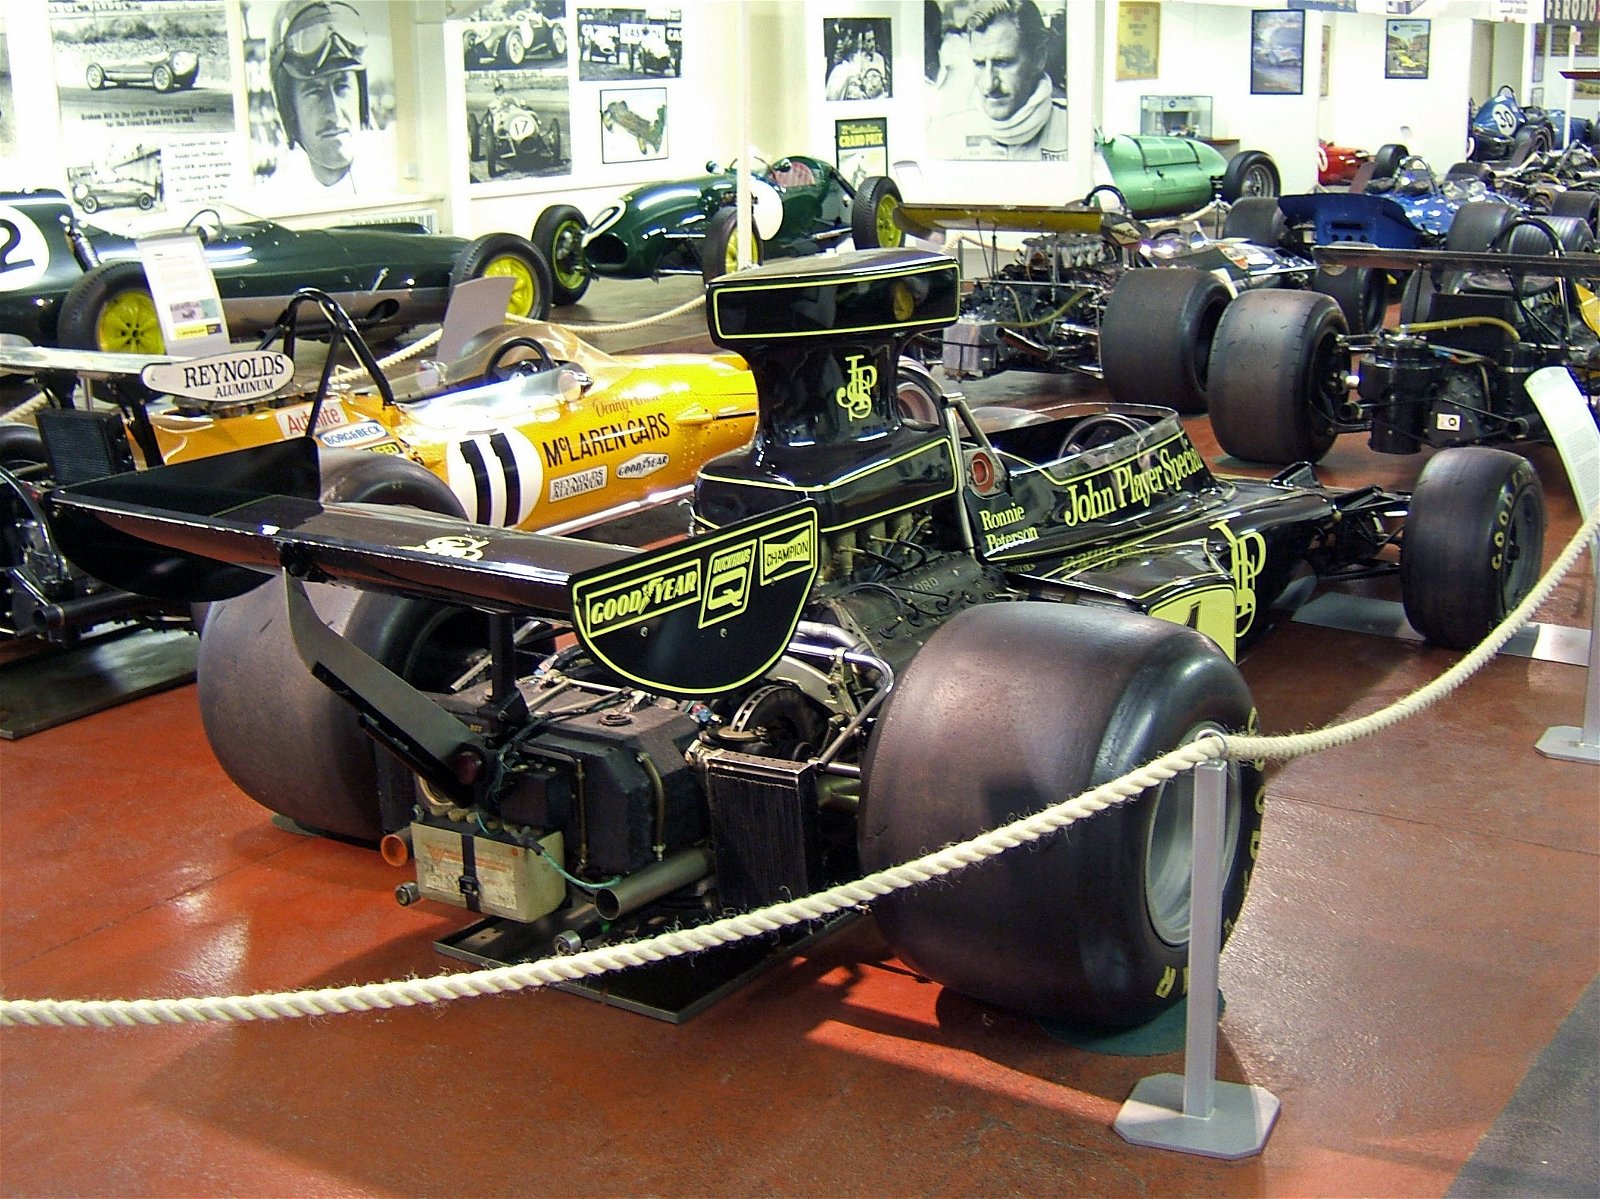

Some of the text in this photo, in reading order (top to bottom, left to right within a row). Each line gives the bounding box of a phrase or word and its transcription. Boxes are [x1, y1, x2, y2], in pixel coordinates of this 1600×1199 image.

[514, 120, 528, 135] 17
[1495, 110, 1515, 128] 30
[839, 132, 884, 148] GRAND PRIX
[184, 354, 285, 389] REYNOLDS
[215, 378, 274, 399] ALUMINUM
[286, 406, 341, 435] Autlite
[627, 412, 670, 445] CARS
[459, 433, 521, 527] 11
[553, 469, 604, 491] REYNOLDS
[553, 479, 604, 500] ALUMINUM
[1064, 480, 1118, 527] John
[1114, 463, 1164, 509] Player
[979, 503, 1026, 531] Ronnie
[985, 526, 1040, 552] Peterson
[766, 539, 809, 568] CHAMPION
[590, 570, 698, 625] GOODYEAR
